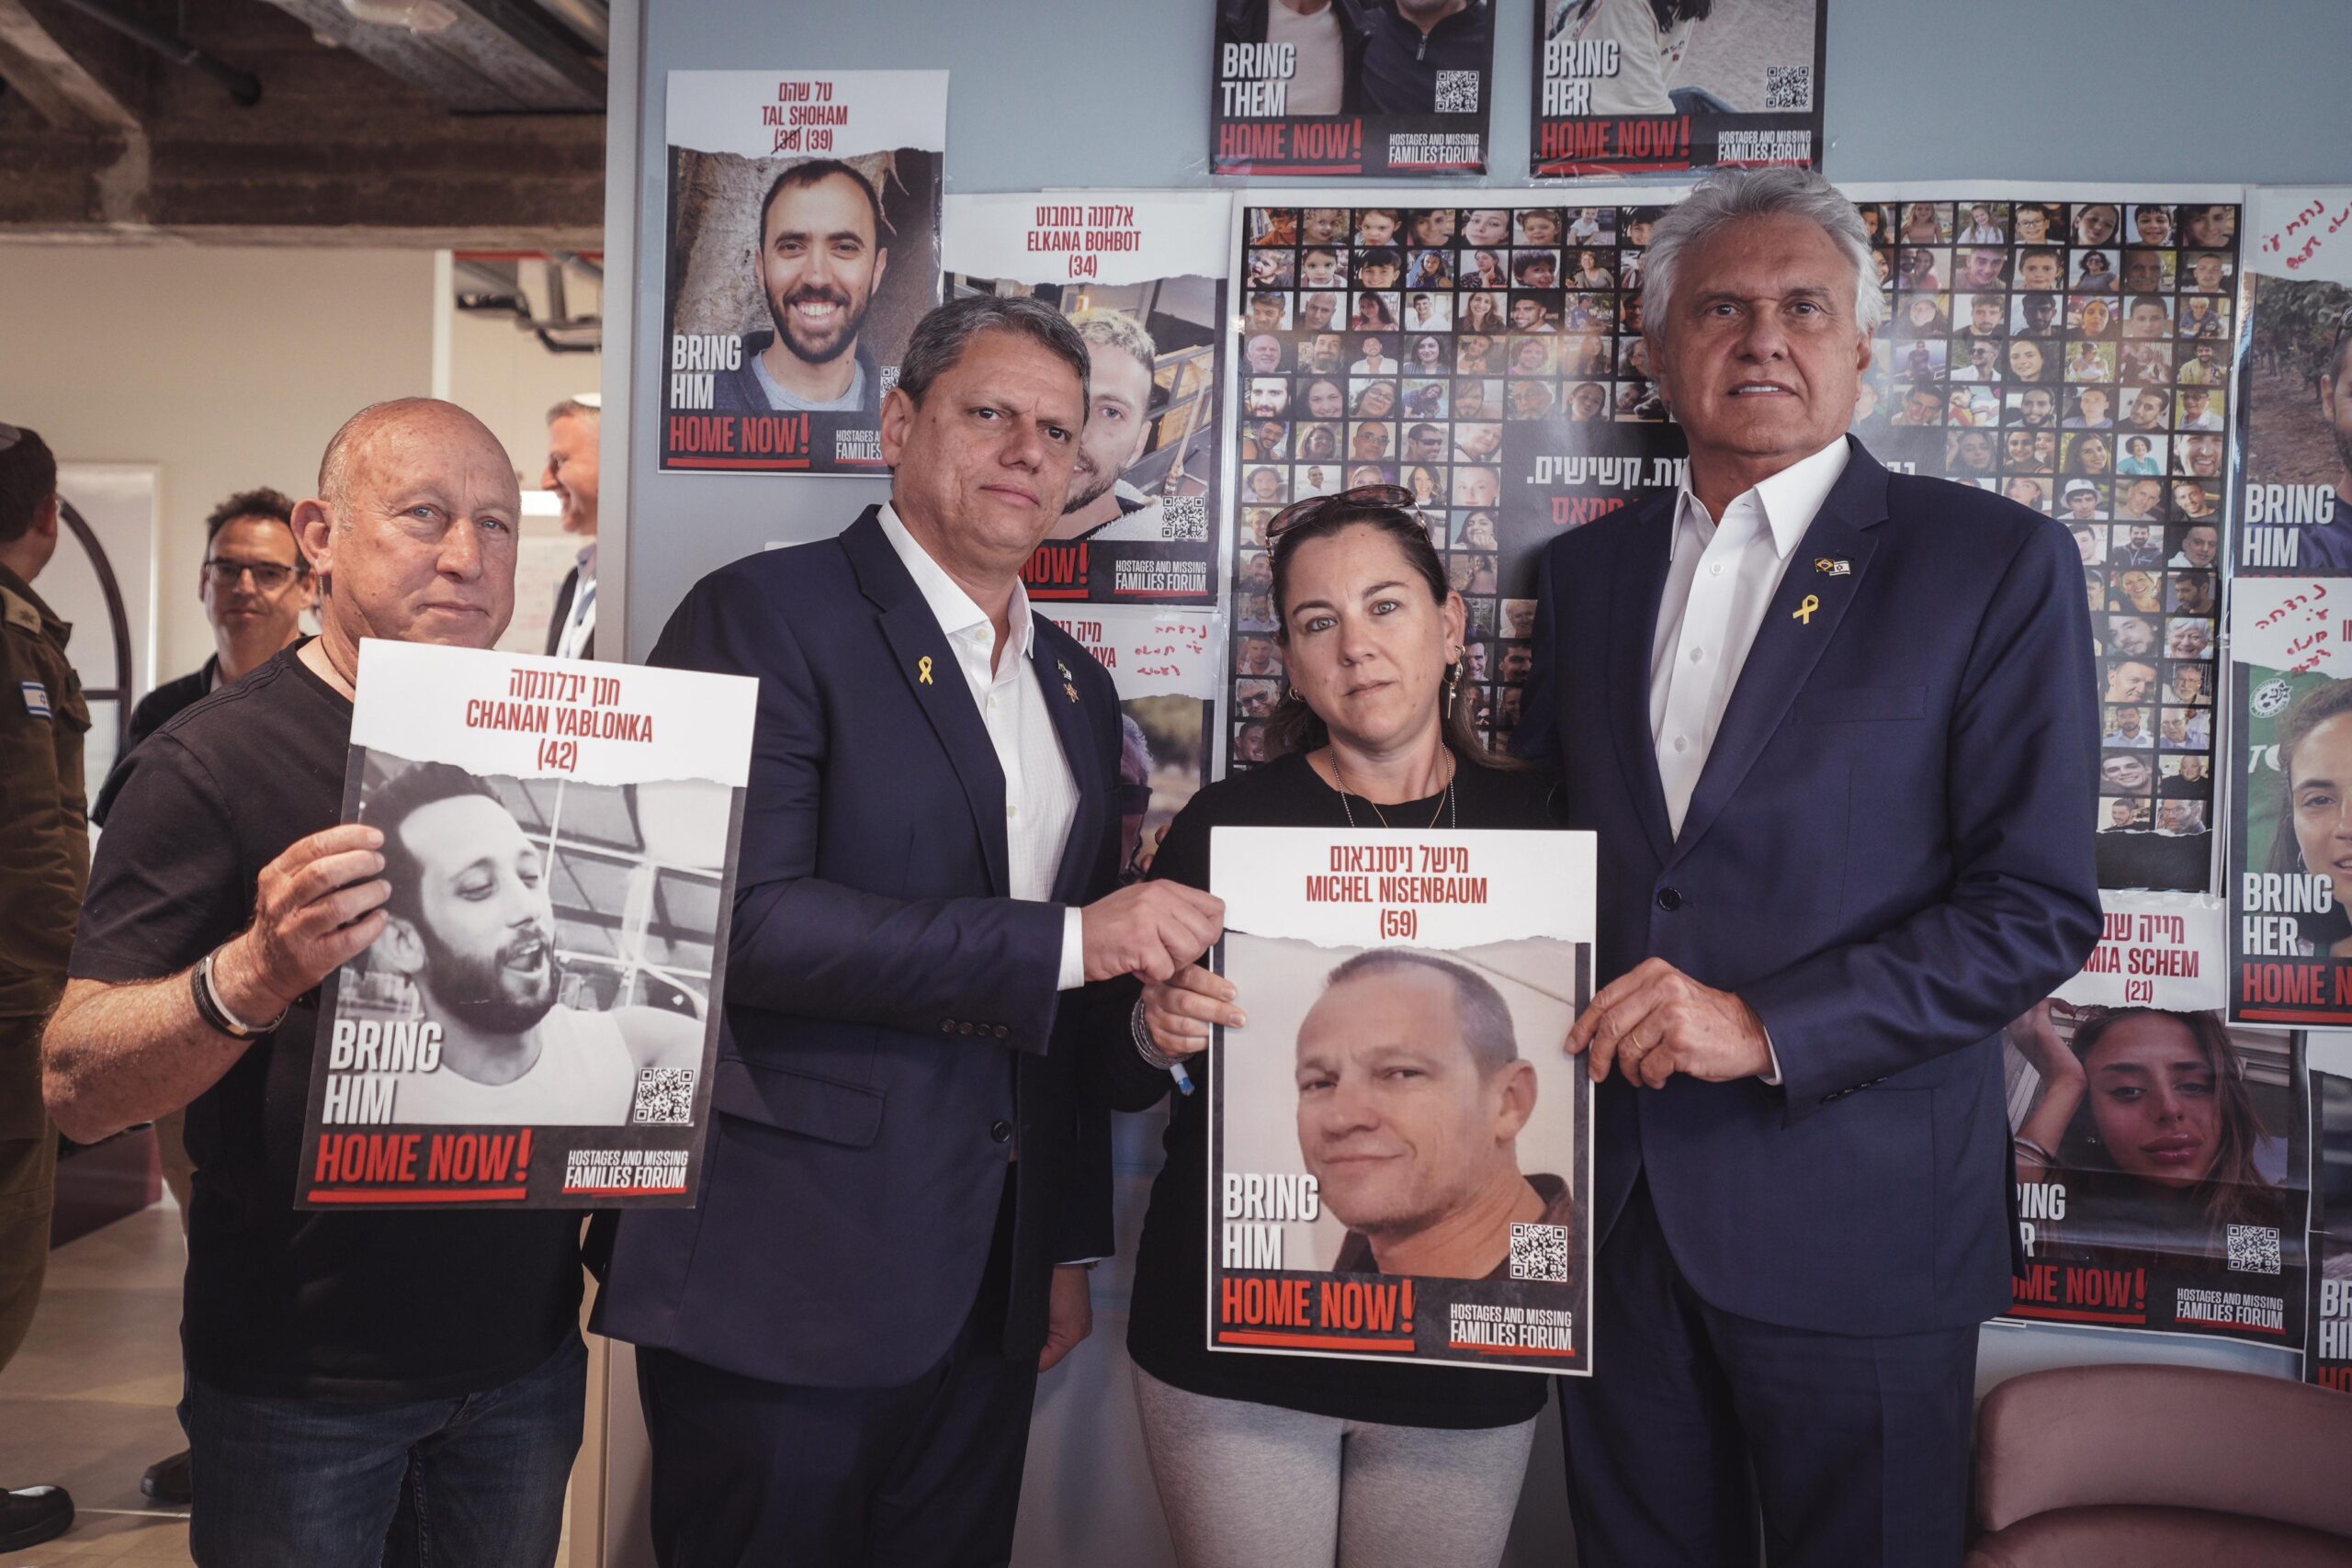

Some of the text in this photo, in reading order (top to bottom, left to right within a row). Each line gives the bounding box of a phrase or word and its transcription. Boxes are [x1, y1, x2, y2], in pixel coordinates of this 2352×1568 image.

[1222, 42, 1295, 78] BRING
[1545, 39, 1620, 78] BRING
[778, 81, 832, 102] טל שהם
[1221, 81, 1287, 117] THEM
[1542, 79, 1590, 116] HER
[762, 106, 848, 125] TAL SHOHAM
[806, 129, 832, 152] (39)
[1220, 118, 1363, 160] HOME NOW!
[1390, 133, 1479, 146] HOSTAGES AND MISSING
[1541, 116, 1690, 159] HOME NOW!
[1718, 130, 1811, 144] HOSTAGES AND MISSING
[1718, 143, 1811, 161] FAMILIES FORUM
[1388, 145, 1478, 164] FAMILIES FORUM
[1035, 205, 1134, 229] אלקנה בוחבוט
[1027, 231, 1141, 252] ELKANA BOHBOT
[1069, 254, 1098, 278] (34)
[672, 334, 742, 371] BRING
[670, 374, 714, 410] HIM
[669, 412, 809, 454] HOME NOW!
[836, 429, 873, 442] HOSTAGES
[835, 442, 882, 460] FAMILIES
[2245, 483, 2335, 525] BRING
[2243, 527, 2299, 567] HIM
[1019, 543, 1088, 584] NOW!
[1115, 559, 1206, 574] HOSTAGES AND MISSING
[1115, 573, 1206, 592] FAMILIES FORUM
[1077, 621, 1102, 642] מיה
[1085, 647, 1116, 668] AYA
[509, 669, 620, 707] חנן יבלונקה
[466, 699, 652, 743] CHANAN YABLONKA
[537, 738, 578, 773] (42)
[1330, 844, 1468, 873] מישל ניסנבאום
[1306, 875, 1487, 904] MICHEL NISENBAUM
[2243, 873, 2333, 914] BRING
[1380, 908, 1418, 940] (59)
[2140, 915, 2184, 944] מייה
[2243, 916, 2299, 955] HER
[2083, 946, 2199, 977] MIA SCHEM
[2125, 979, 2153, 1003] (21)
[2243, 963, 2325, 1005] HOME
[329, 1020, 442, 1072] BRING
[322, 1075, 395, 1124] HIM
[315, 1127, 533, 1182] HOME NOW!
[568, 1150, 688, 1166] HOSTAGES AND MISSING
[564, 1166, 686, 1189] FAMILIES FORUM
[1223, 1173, 1318, 1221] BRING
[2017, 1183, 2065, 1220] ING
[1223, 1223, 1282, 1270] HIM
[2013, 1264, 2145, 1310] ME NOW!
[2177, 1288, 2283, 1311] HOSTAGES AND MISSING
[1222, 1278, 1415, 1333] HOME NOW!
[1451, 1303, 1572, 1327] HOSTAGES AND MISSING
[2177, 1301, 2283, 1330] FAMILIES FORUM
[1451, 1320, 1572, 1351] FAMILIES FORUM
[2319, 1321, 2352, 1359] HI
